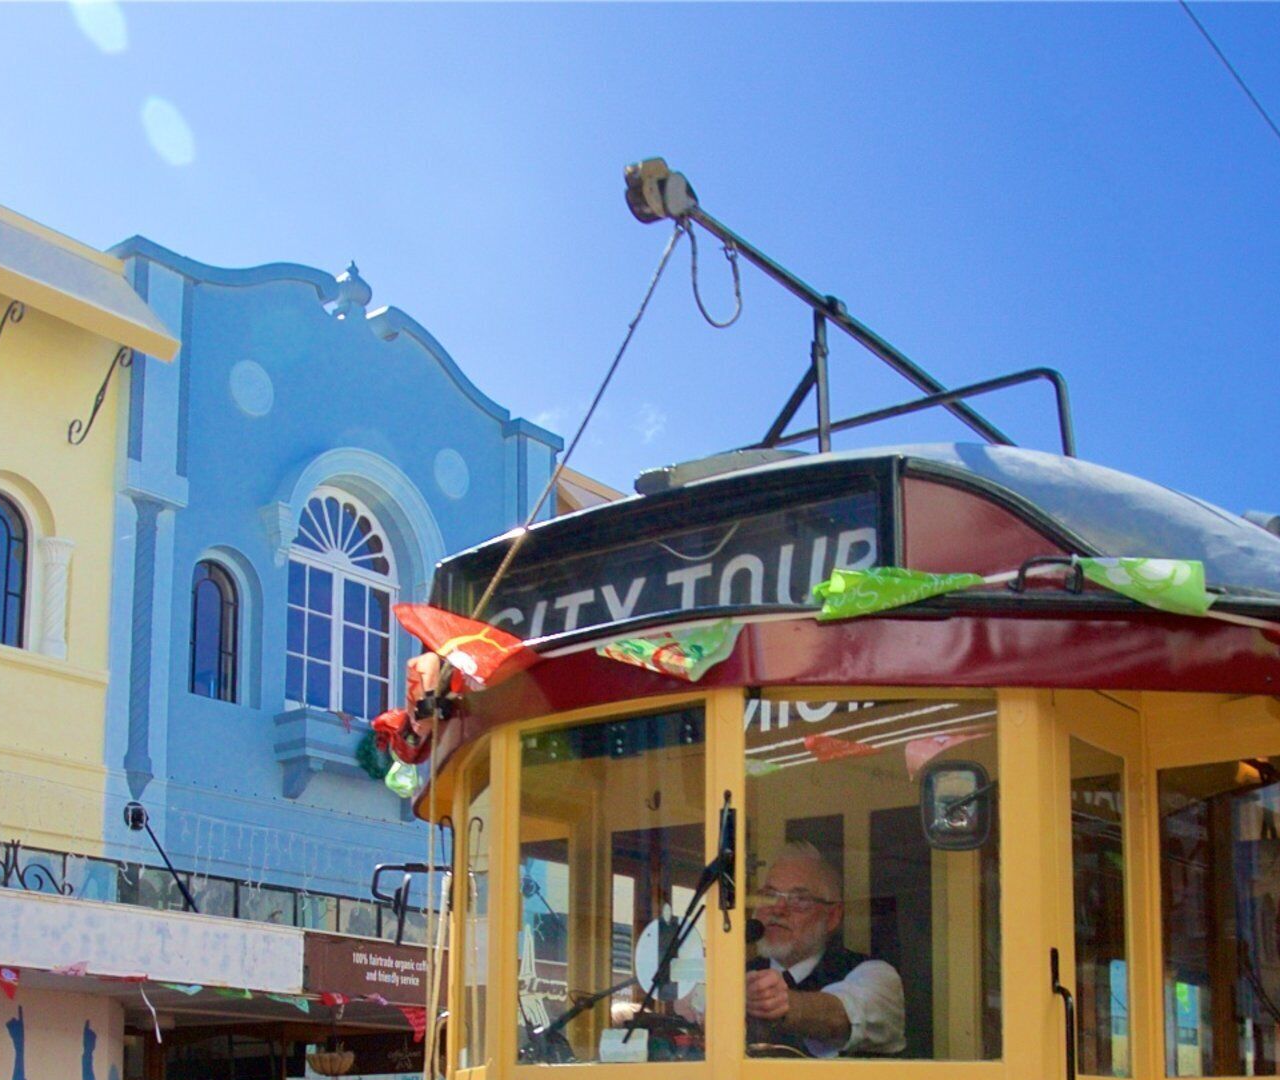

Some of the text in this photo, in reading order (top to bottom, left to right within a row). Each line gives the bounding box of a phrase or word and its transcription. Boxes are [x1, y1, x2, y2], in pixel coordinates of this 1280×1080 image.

[352, 951, 369, 966] 100%
[369, 953, 394, 969] fairtrade
[394, 957, 415, 972] organic
[366, 970, 420, 987] and friendly service
